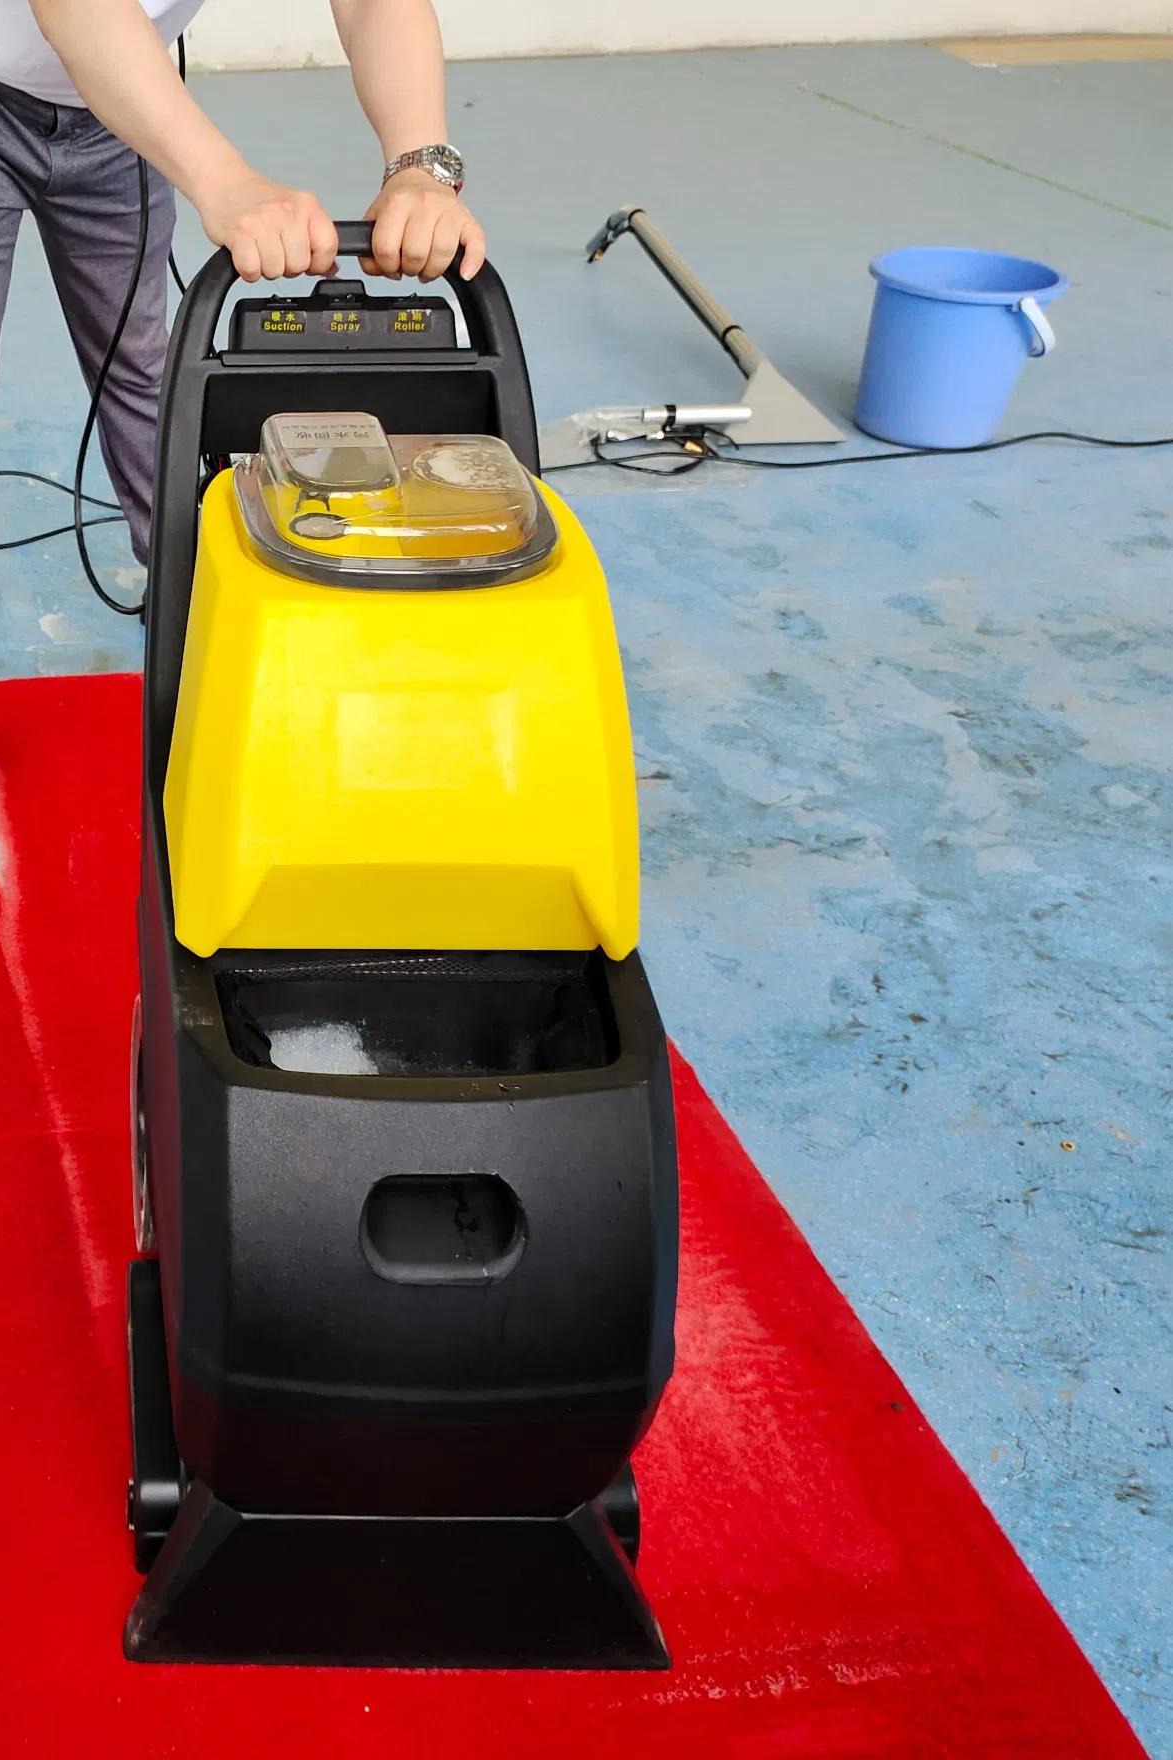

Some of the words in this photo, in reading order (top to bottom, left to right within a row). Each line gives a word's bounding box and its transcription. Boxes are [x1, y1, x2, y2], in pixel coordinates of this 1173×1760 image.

[264, 322, 302, 331] Suction
[330, 322, 360, 332] Spray
[394, 322, 425, 331] Roller
